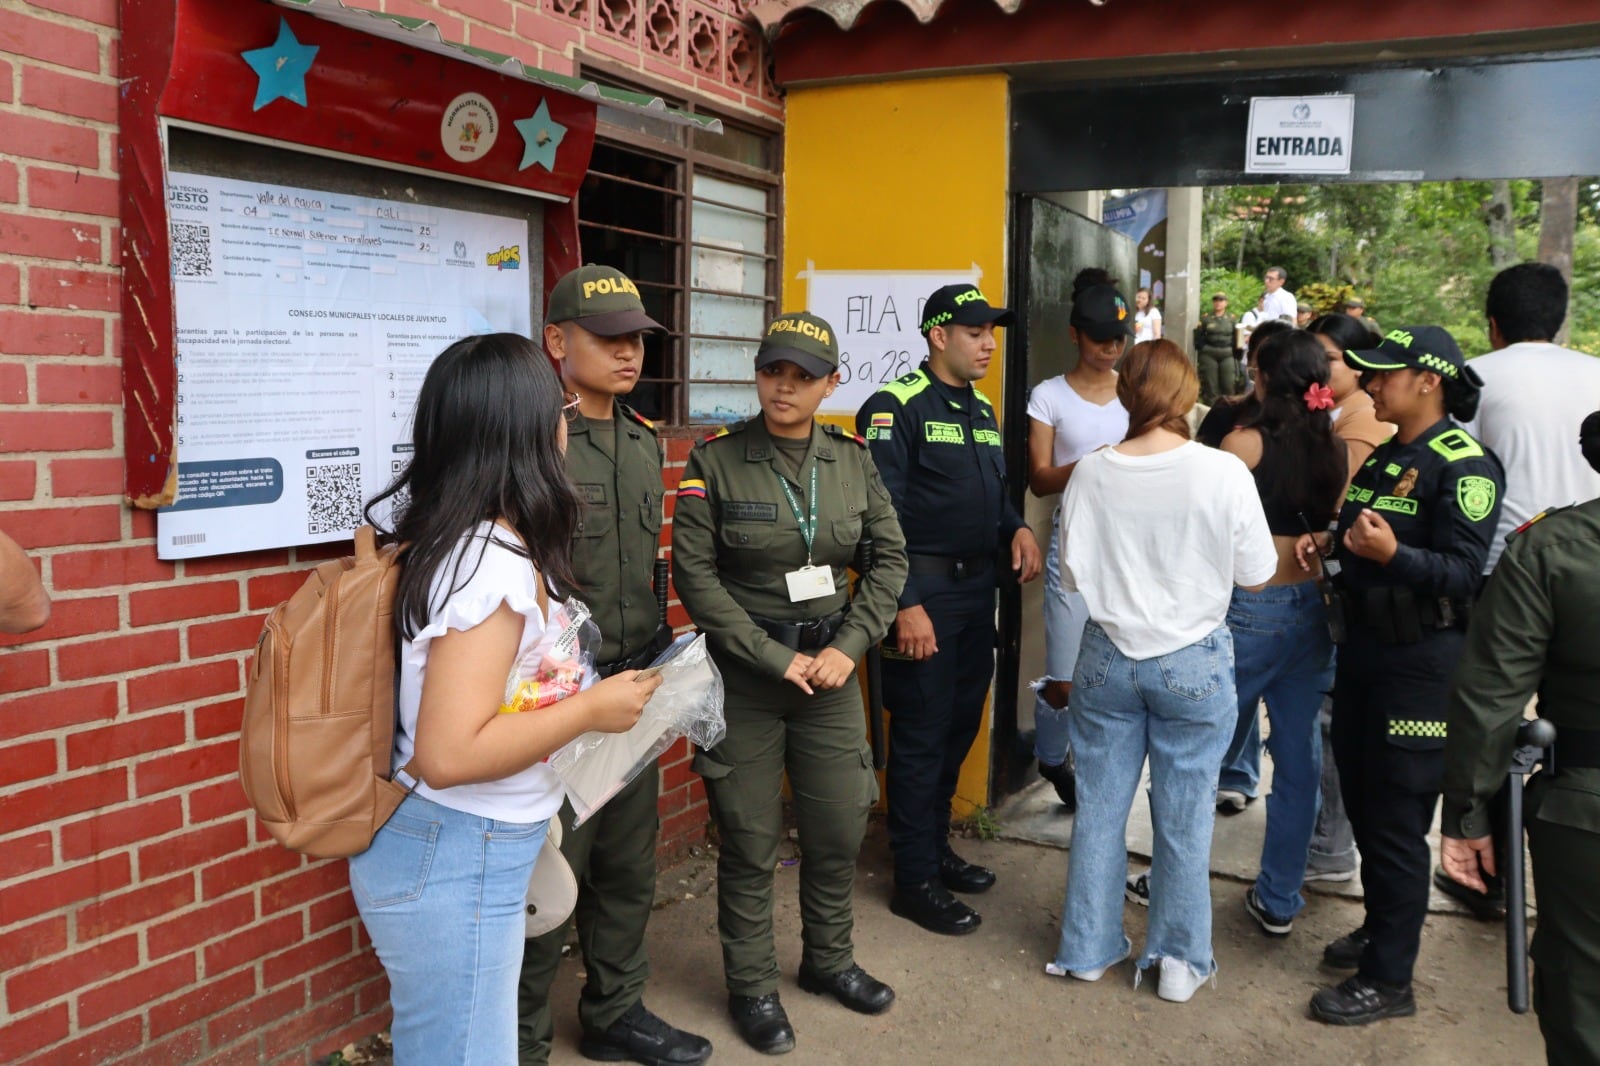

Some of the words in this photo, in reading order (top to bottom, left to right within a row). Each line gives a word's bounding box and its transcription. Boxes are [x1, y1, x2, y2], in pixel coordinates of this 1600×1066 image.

[447, 100, 477, 127] NORMALISTA
[478, 102, 494, 133] SUPERIOR
[1256, 137, 1343, 156] ENTRADA
[256, 191, 274, 205] Valle
[279, 192, 291, 207] del
[419, 226, 431, 236] 25
[582, 277, 641, 299] POLIC
[288, 309, 328, 318] CONSEJOS
[328, 311, 371, 320] MUNICIPALES
[378, 313, 405, 321] LOCALES
[416, 315, 447, 323] JUVENTUD
[846, 295, 901, 335] FILA
[767, 319, 830, 346] POLICIA
[858, 361, 873, 384] a
